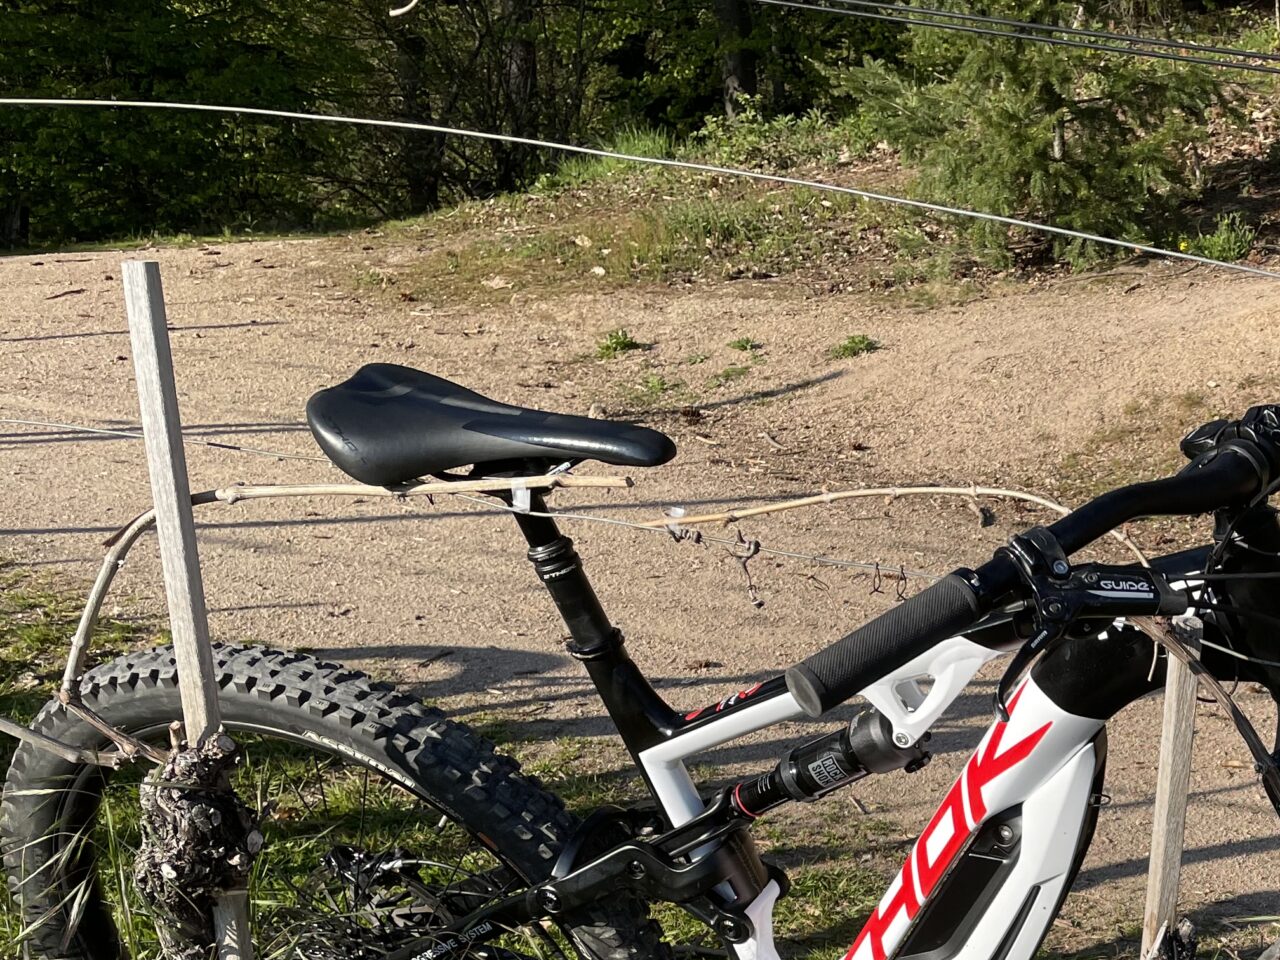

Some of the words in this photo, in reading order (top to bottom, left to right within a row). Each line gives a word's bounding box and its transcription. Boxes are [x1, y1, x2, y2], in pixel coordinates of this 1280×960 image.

[1100, 580, 1149, 591] GUIDE
[822, 757, 846, 781] ROCK
[458, 921, 494, 944] SYSTEM
